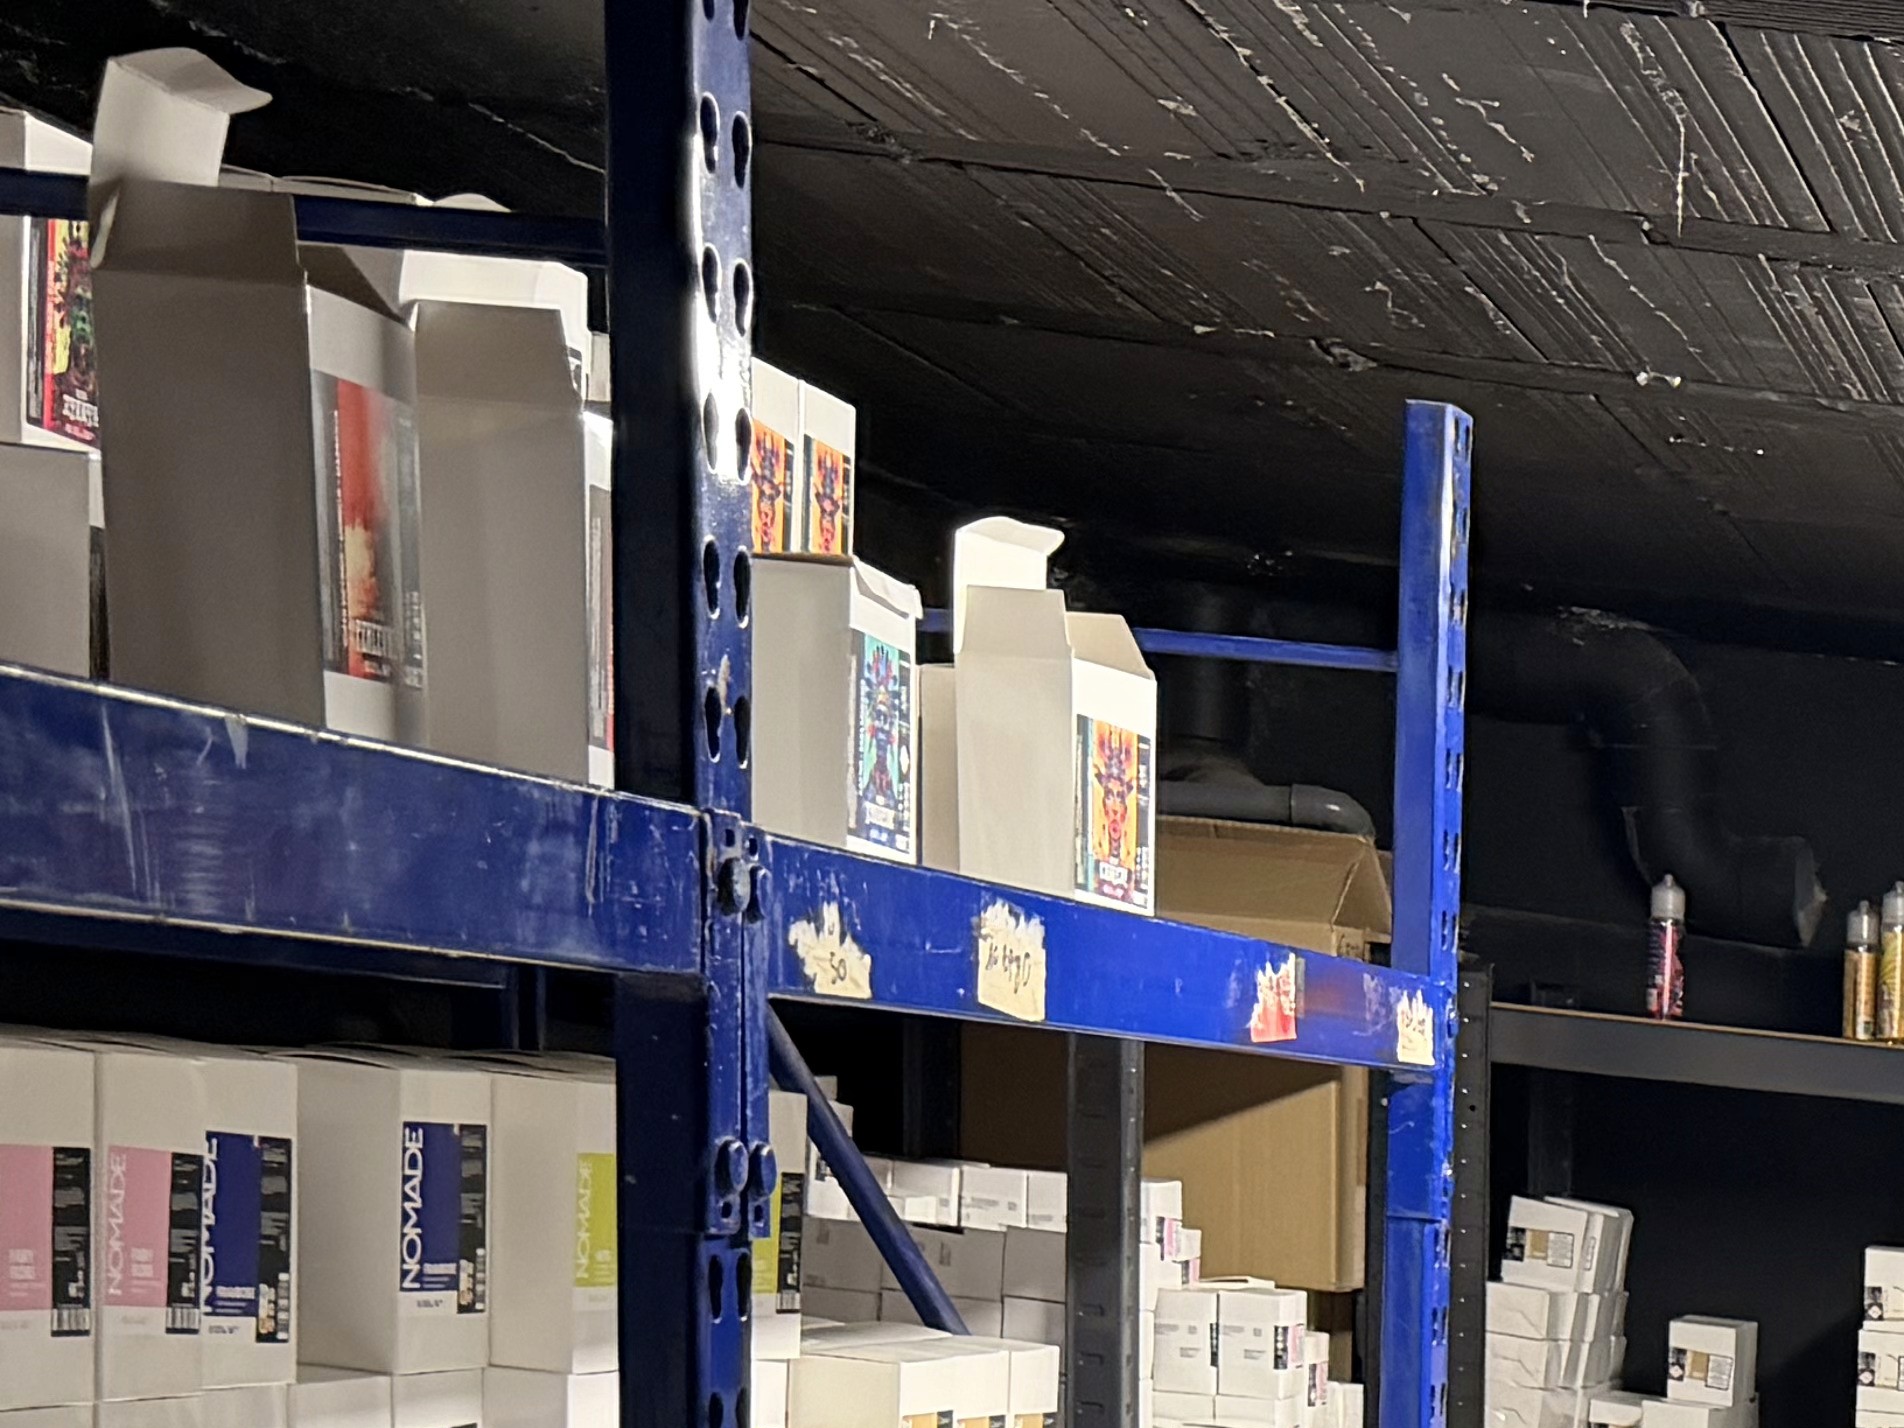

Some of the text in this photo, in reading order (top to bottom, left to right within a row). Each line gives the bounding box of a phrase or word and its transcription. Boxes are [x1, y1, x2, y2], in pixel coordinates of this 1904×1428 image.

[108, 1153, 127, 1296] NOMADE
[402, 1126, 424, 1290] NOMADE
[576, 1160, 593, 1280] NOMADE
